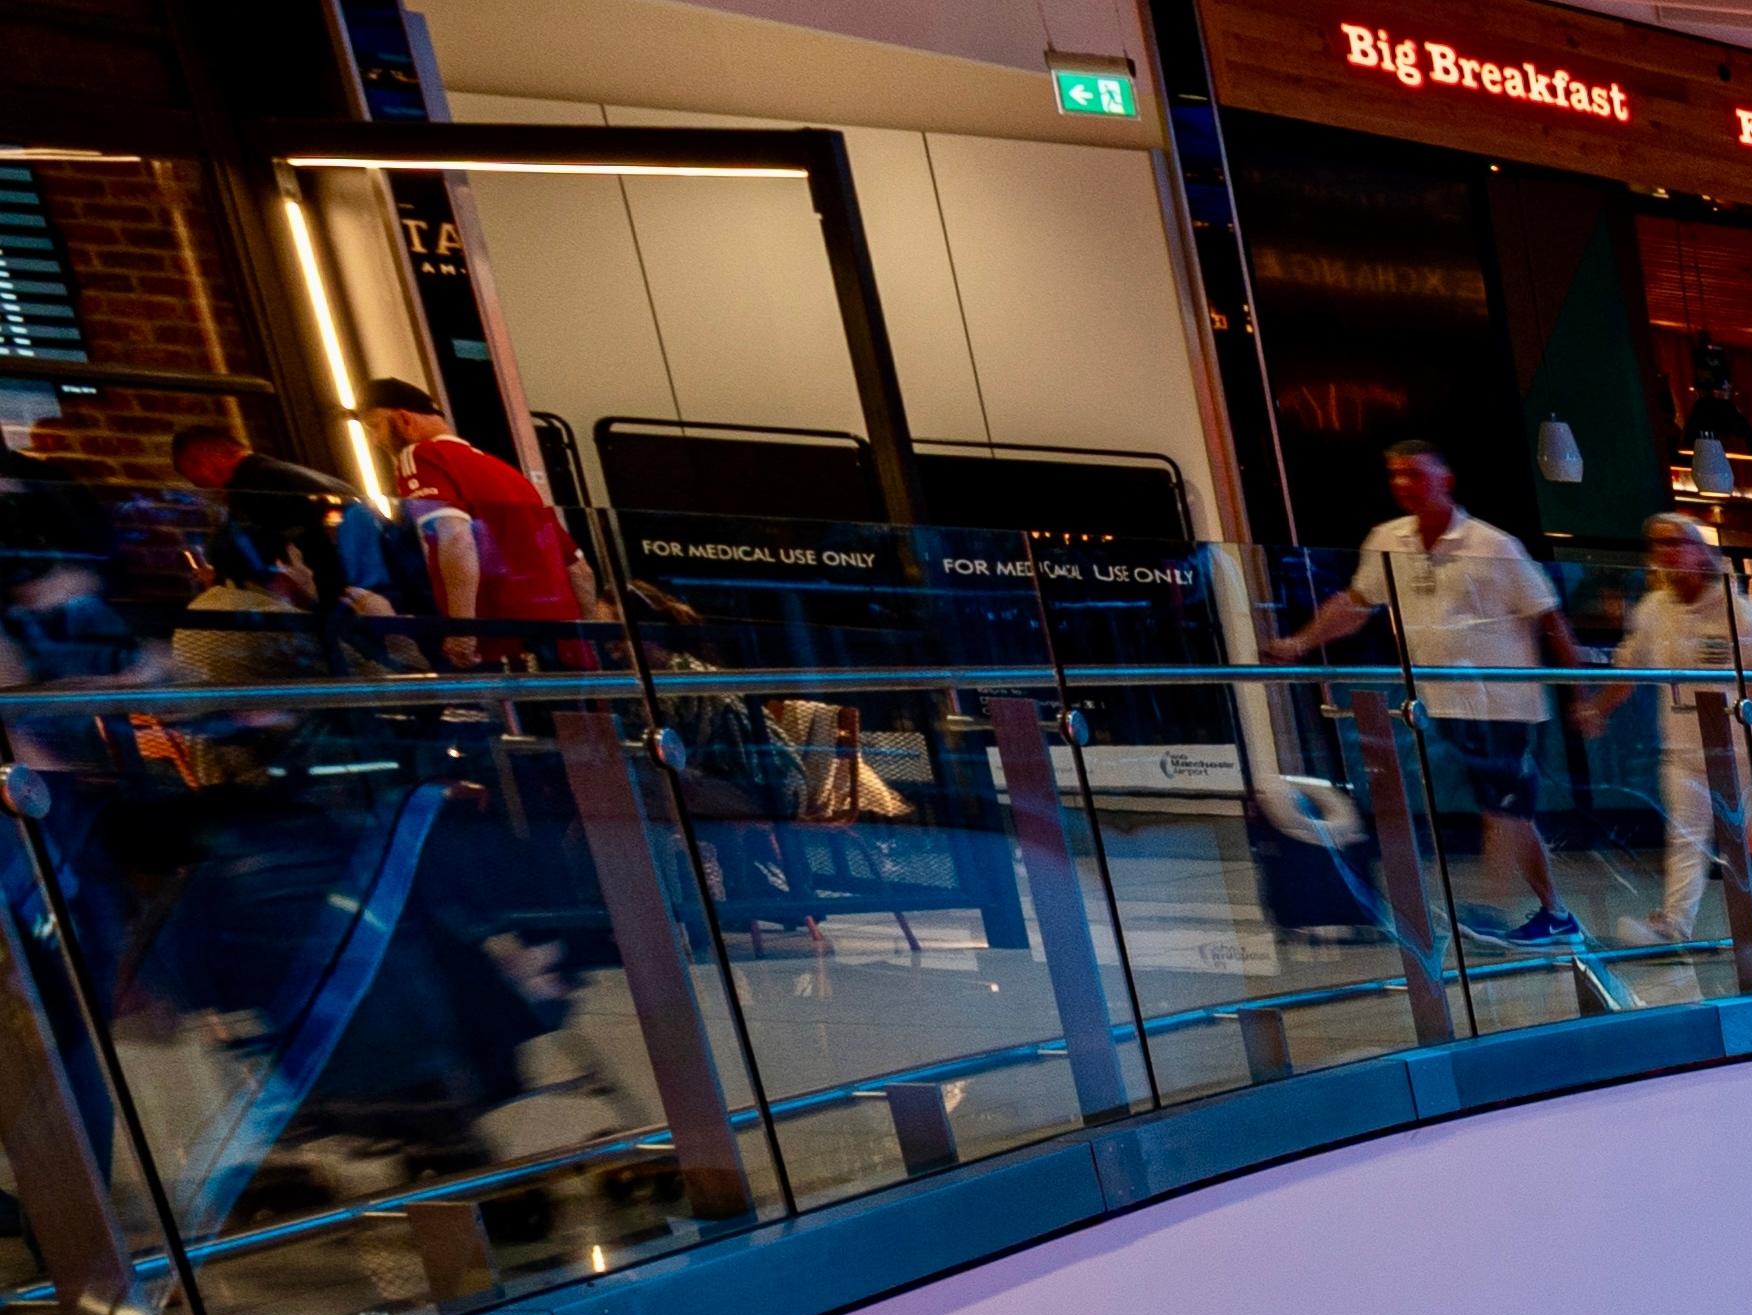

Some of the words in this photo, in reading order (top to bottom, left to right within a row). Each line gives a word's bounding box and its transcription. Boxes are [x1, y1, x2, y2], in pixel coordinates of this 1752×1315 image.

[1341, 22, 1424, 88] Big
[1426, 41, 1630, 121] Breakfast
[642, 539, 684, 558] FOR
[689, 543, 776, 563] MEDICAL
[780, 547, 817, 566] USE
[822, 550, 876, 569] ONLY
[943, 557, 990, 577] FOR
[1134, 566, 1195, 586] ONLY
